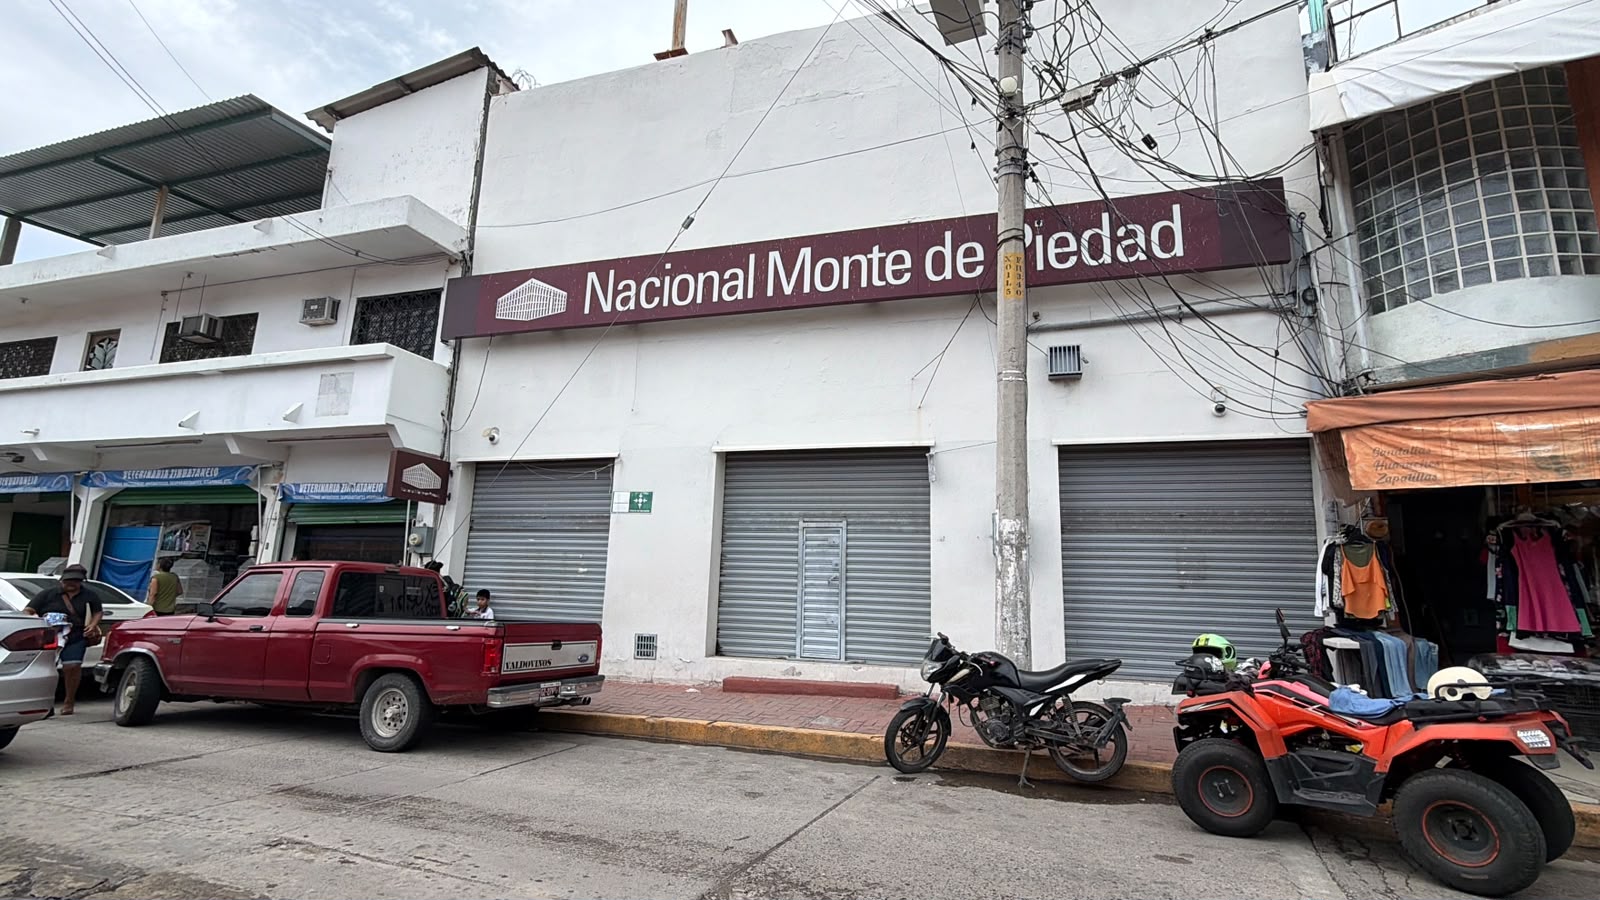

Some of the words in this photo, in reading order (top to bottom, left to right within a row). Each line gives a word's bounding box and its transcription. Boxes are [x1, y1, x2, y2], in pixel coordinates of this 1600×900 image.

[584, 253, 756, 315] Nacional
[766, 244, 912, 297] Monte
[924, 231, 985, 282] de
[1376, 472, 1437, 485] Zapatillas
[299, 483, 340, 493] VETERINARIA
[505, 659, 552, 669] VALDOVINOS
